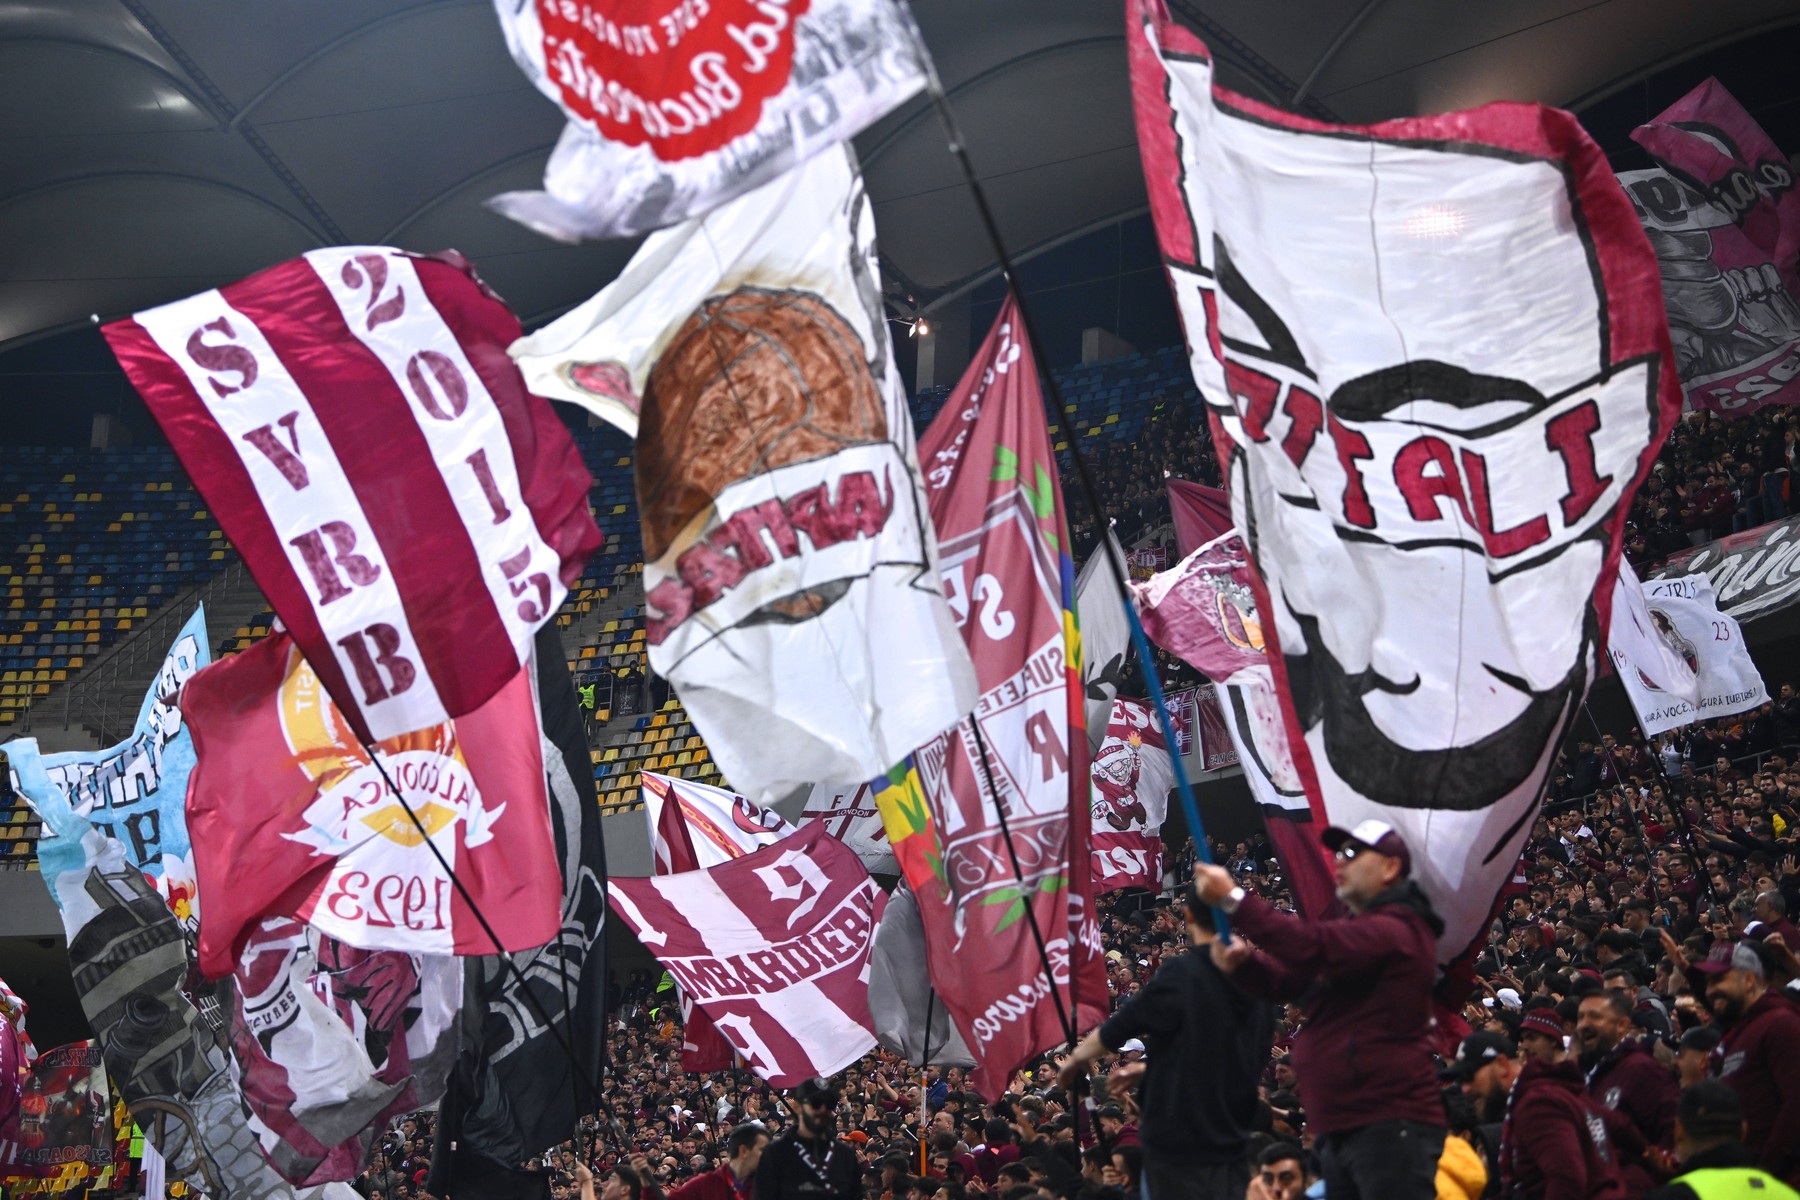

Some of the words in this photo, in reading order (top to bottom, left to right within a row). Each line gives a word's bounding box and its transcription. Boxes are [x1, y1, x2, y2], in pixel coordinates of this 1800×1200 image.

[341, 254, 552, 623] 2015
[186, 315, 416, 706] SVRB
[1711, 621, 1730, 641] 23
[1208, 752, 1226, 767] FAN
[1226, 750, 1240, 763] CL
[836, 808, 870, 817] LONDON
[248, 987, 300, 1031] CURES
